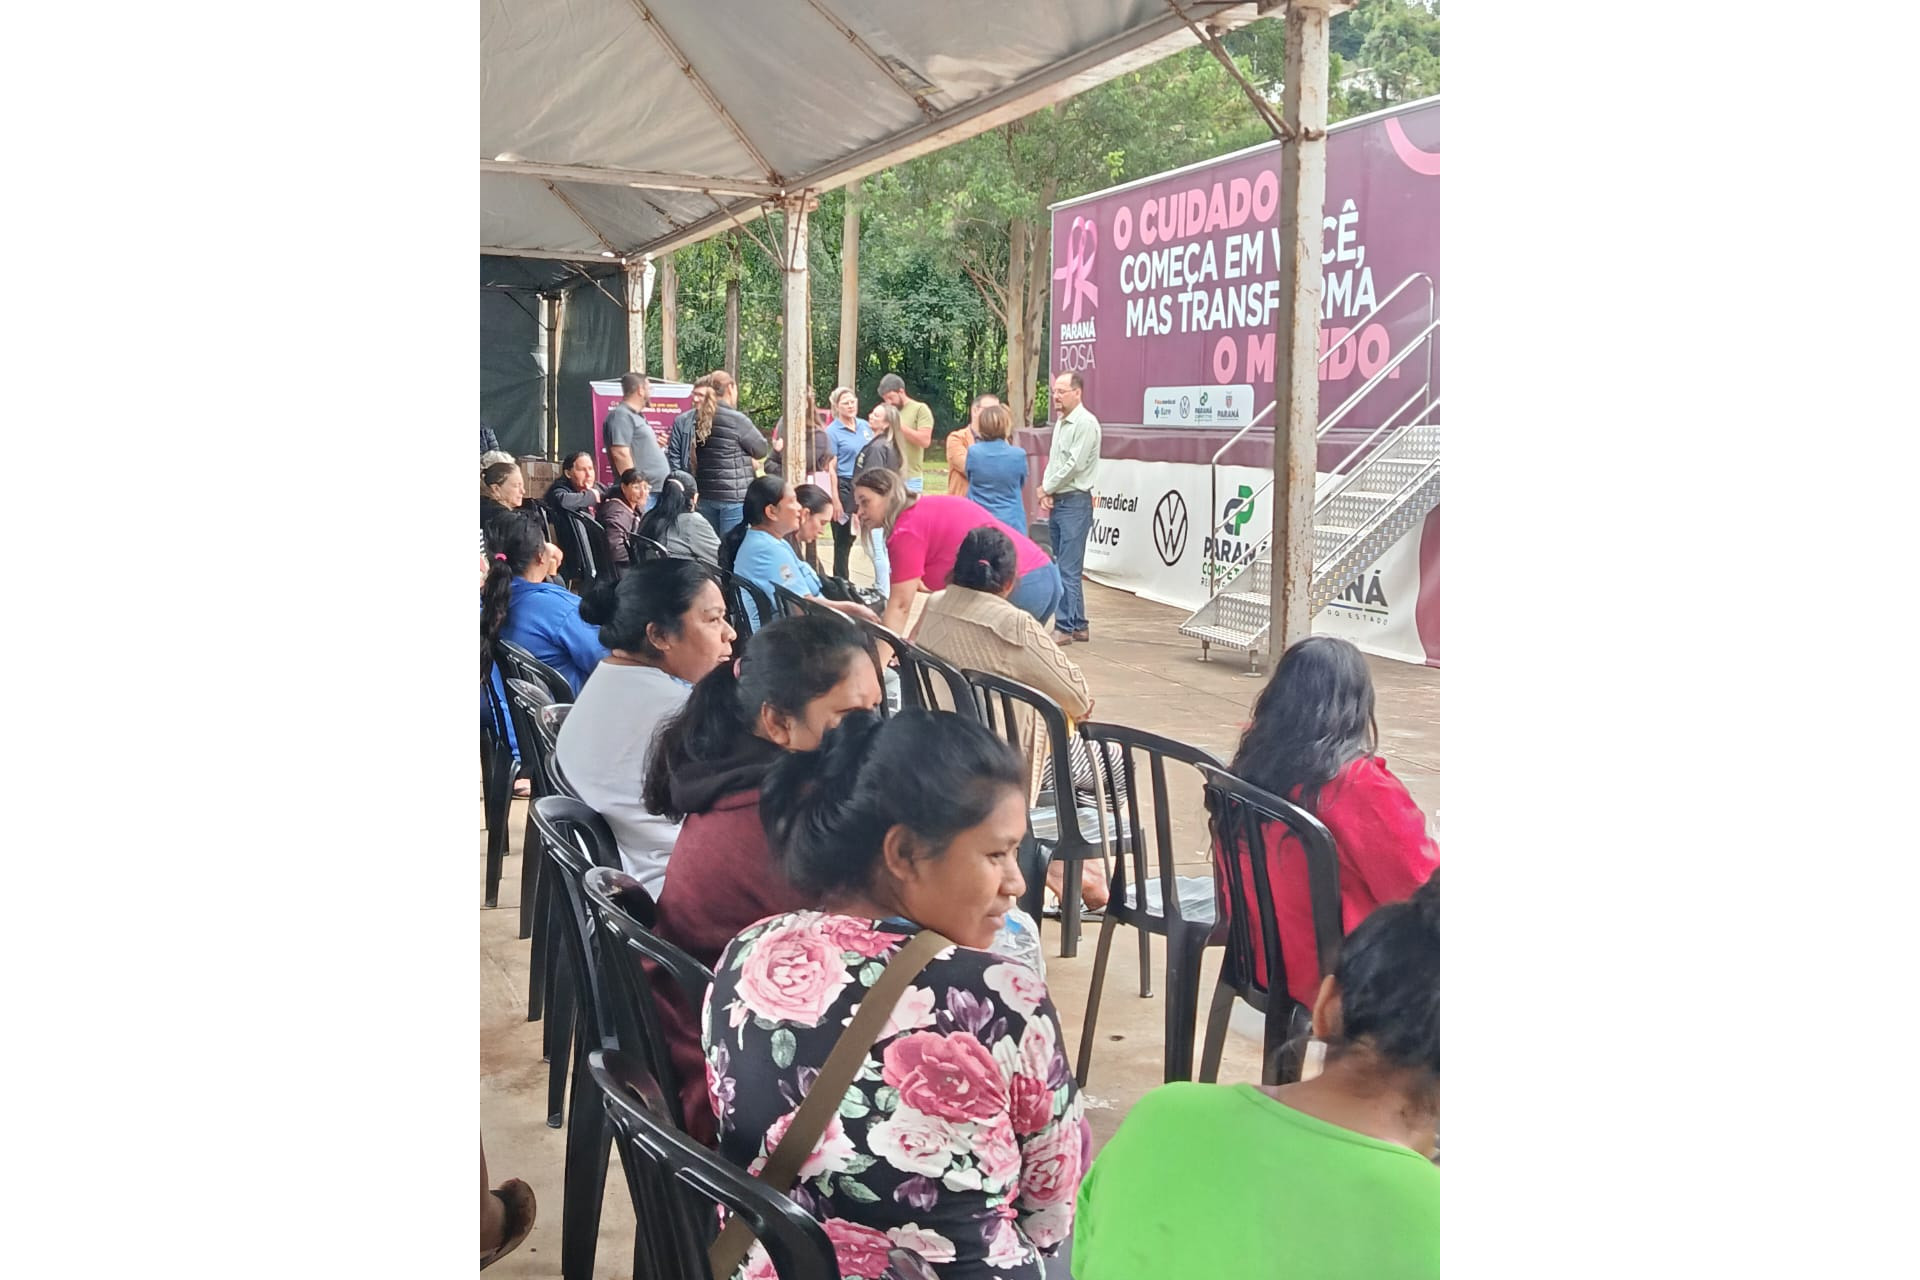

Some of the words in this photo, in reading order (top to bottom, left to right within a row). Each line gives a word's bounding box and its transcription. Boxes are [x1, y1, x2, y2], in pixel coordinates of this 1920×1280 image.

[1113, 205, 1133, 251] O
[1139, 169, 1279, 246] CUIDADO
[1119, 243, 1218, 295] COMEÇA
[1224, 230, 1264, 279] EM
[1272, 198, 1366, 271] VCÊ,
[1125, 297, 1172, 339] MAS
[1177, 266, 1378, 334] TRANSFMA
[1060, 315, 1097, 341] PARANÁ
[1059, 343, 1096, 371] ROSA
[1213, 335, 1238, 385] O
[1245, 323, 1401, 384] MDO.
[1217, 407, 1239, 418] PARANÁ
[1090, 518, 1120, 547] Kure
[1347, 612, 1389, 626] ESTADO
